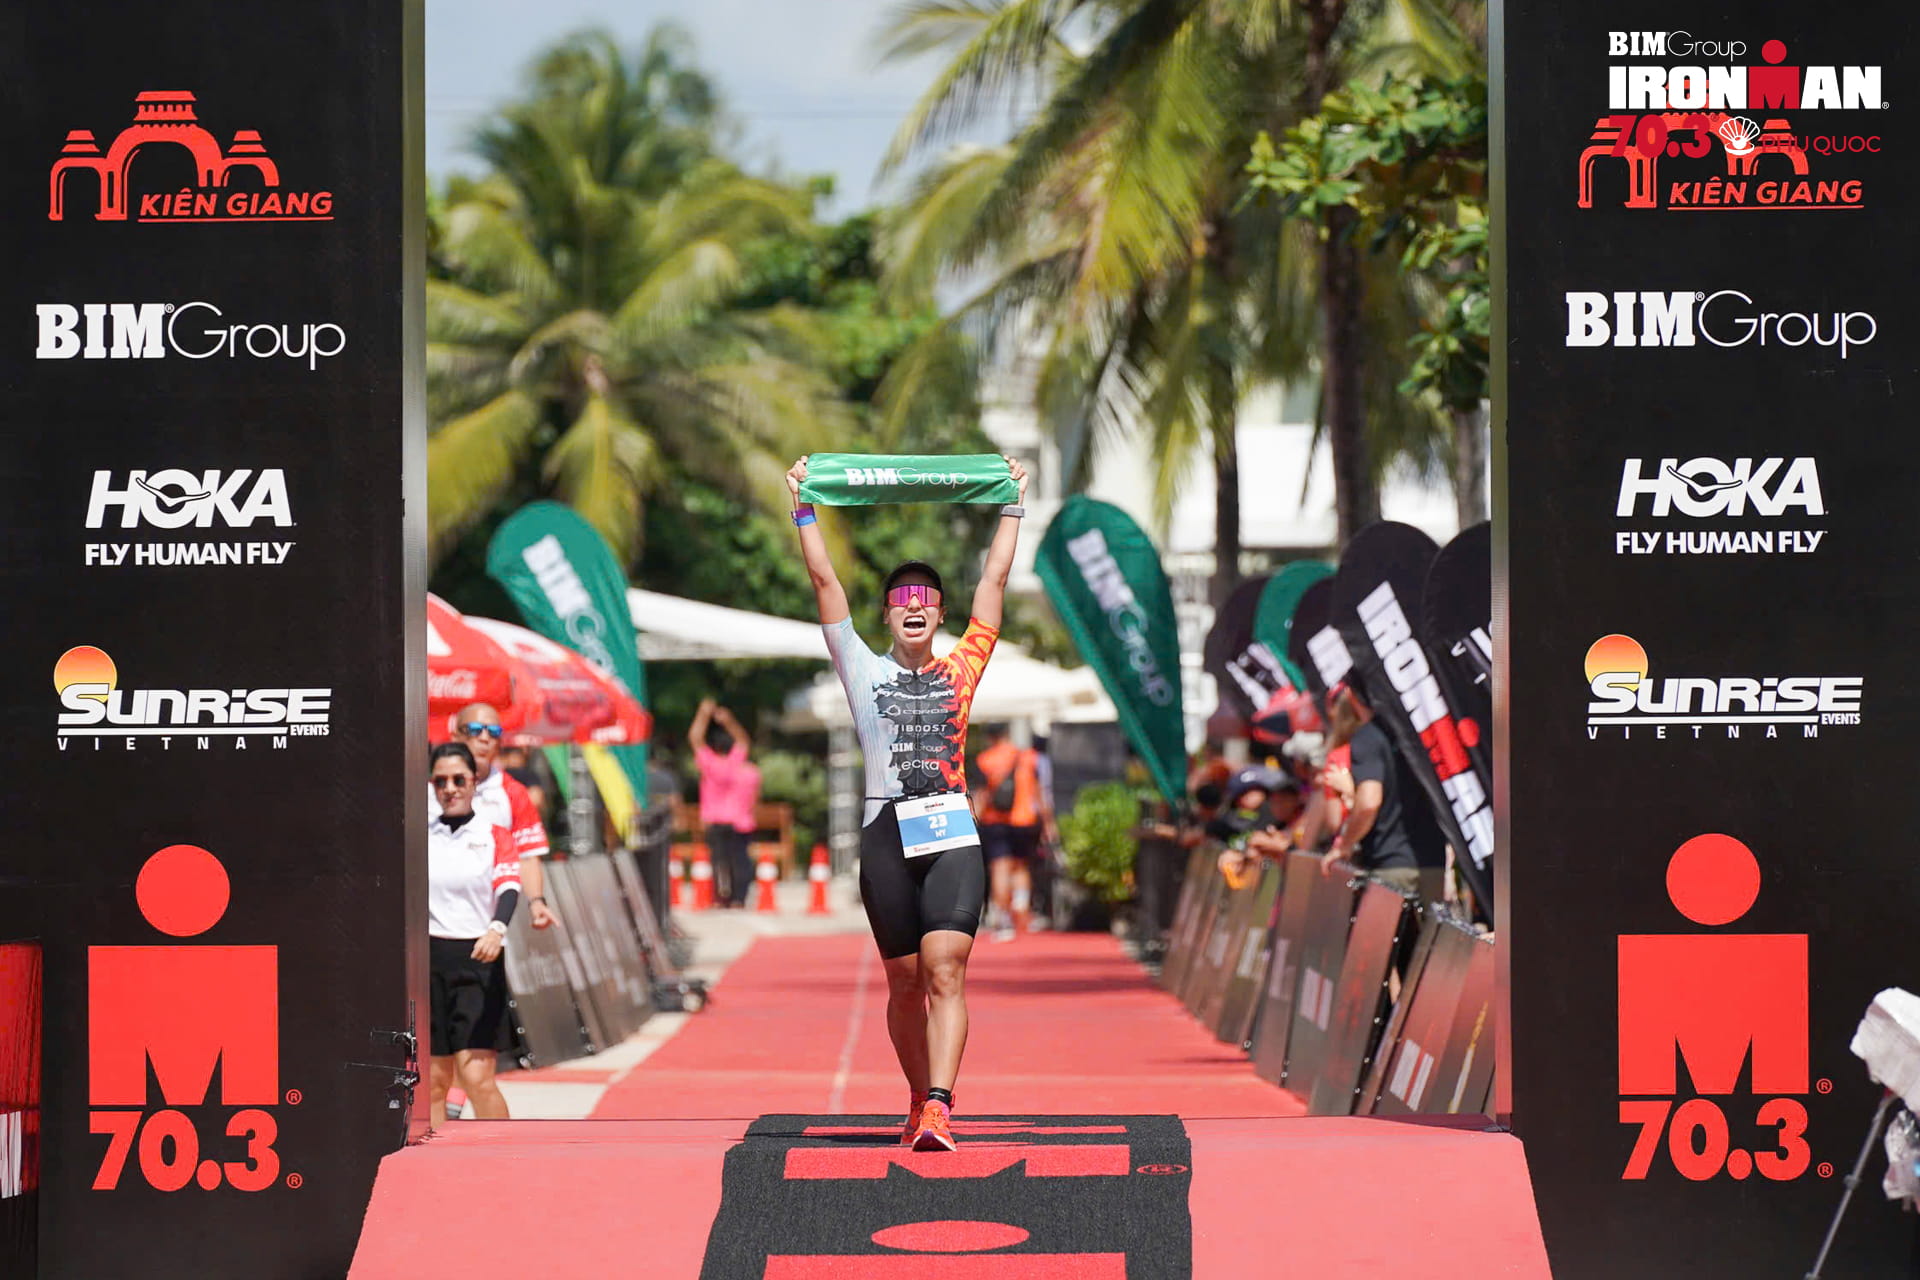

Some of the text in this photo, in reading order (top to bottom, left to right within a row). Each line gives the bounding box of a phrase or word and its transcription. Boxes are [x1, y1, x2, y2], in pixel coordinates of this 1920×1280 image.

[140, 187, 333, 216] KIÊN GIANG
[1669, 176, 1863, 205] KIÊN GIANG
[36, 301, 346, 370] BIMGroup
[1566, 290, 1877, 359] BIMGroup
[844, 467, 968, 489] BIMGroup
[1616, 457, 1825, 518] HOKA
[85, 468, 293, 529] HOKA
[85, 542, 292, 566] FLY HUMAN FLY
[1616, 531, 1824, 555] FLY HUMAN FLY
[289, 724, 330, 736] EVENTS
[1356, 580, 1494, 866] IRONMAN
[1588, 725, 1818, 740] VIETNAM
[1820, 713, 1861, 725] EVENTS
[57, 736, 288, 751] VIETNAM
[928, 814, 948, 829] 23
[89, 1109, 280, 1192] 70.3
[1619, 1098, 1811, 1181] 70.3
